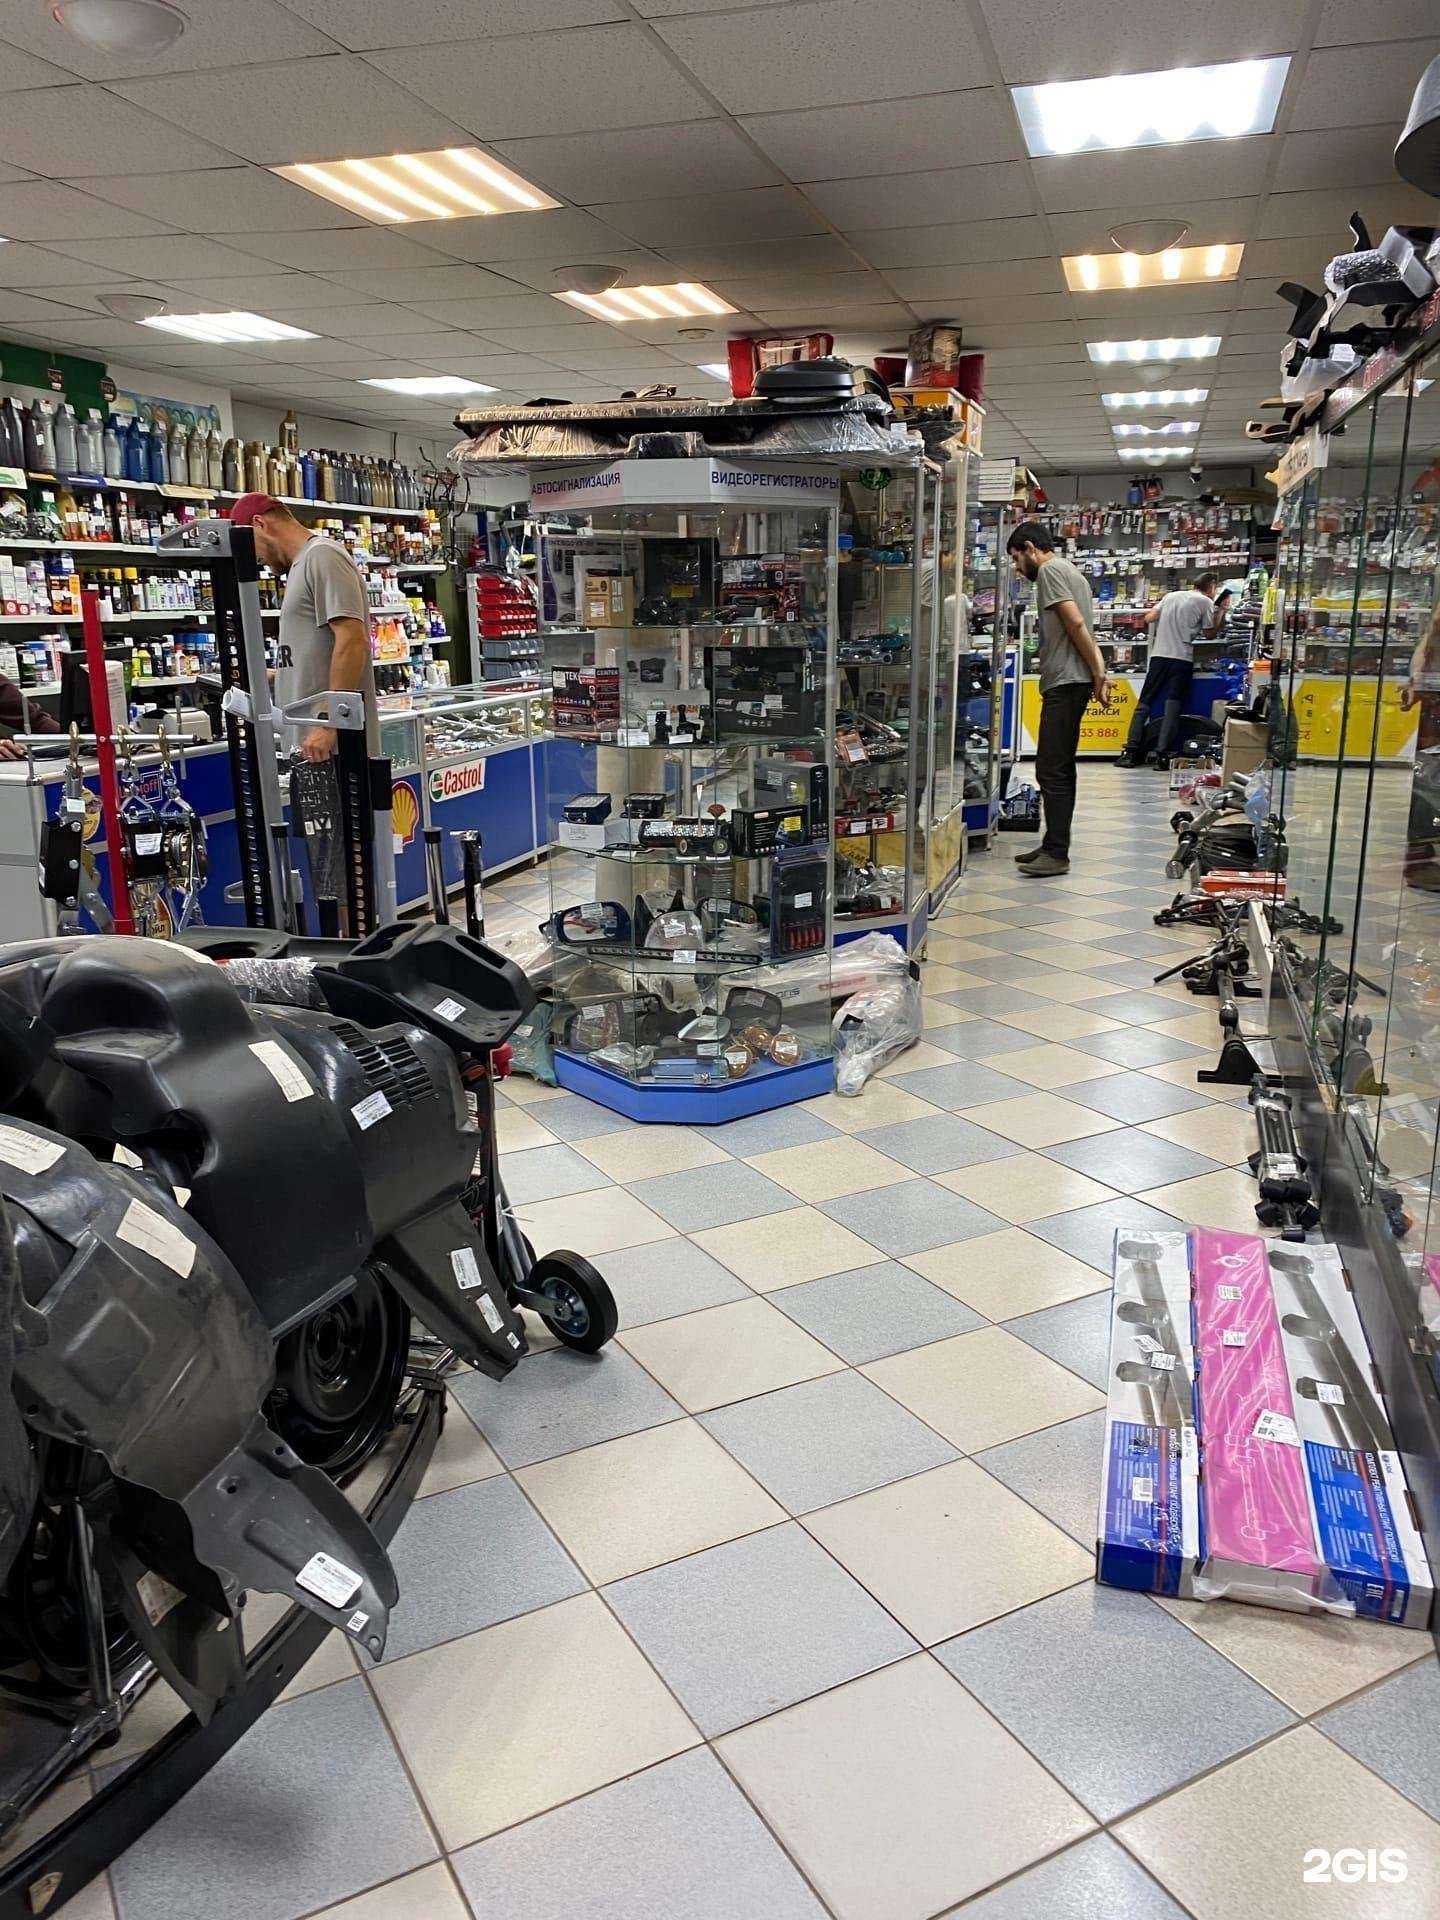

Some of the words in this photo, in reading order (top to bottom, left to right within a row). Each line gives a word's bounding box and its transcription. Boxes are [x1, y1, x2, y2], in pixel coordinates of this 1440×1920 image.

[531, 472, 621, 495] АВТОСИГНАЛИЗАЦИЯ
[711, 471, 840, 489] ВИДЕОРЕГИСТРАТОРЫ
[1098, 728, 1119, 738] 888
[444, 763, 482, 796] Castrol
